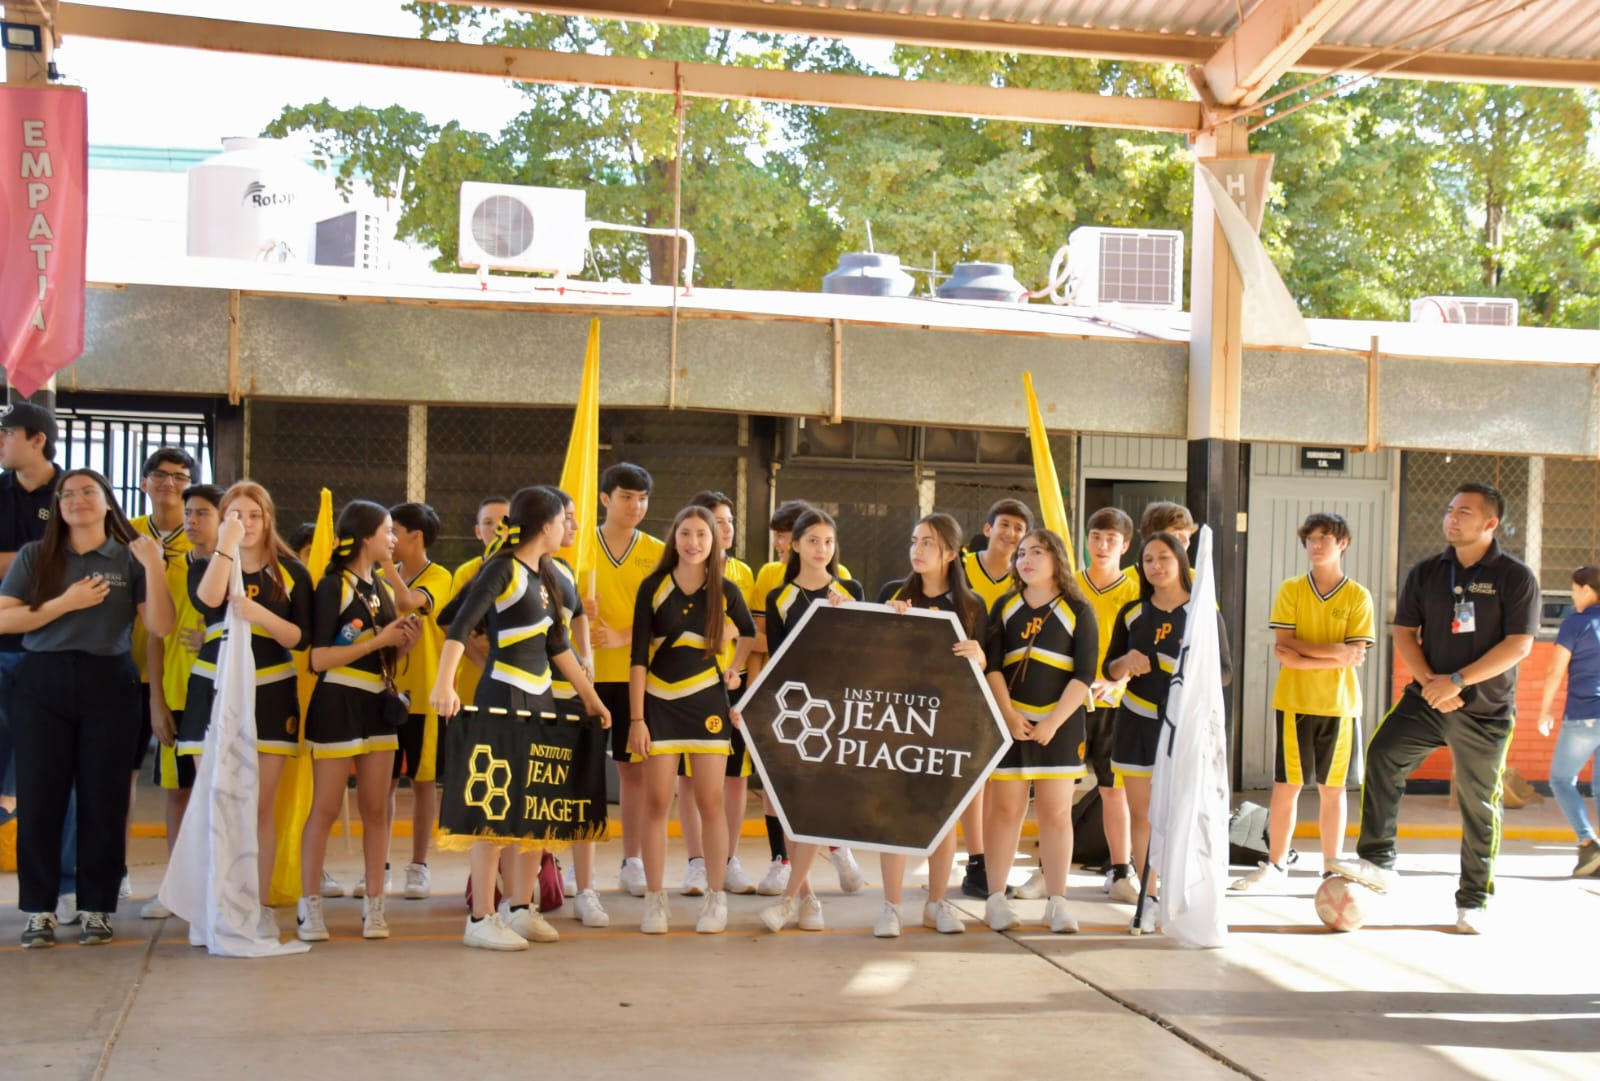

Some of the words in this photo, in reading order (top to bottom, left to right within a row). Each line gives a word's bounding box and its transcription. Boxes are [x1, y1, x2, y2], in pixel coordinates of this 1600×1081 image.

[20, 119, 54, 331] EMPATIA
[844, 687, 941, 709] INSTITUTO
[837, 699, 939, 738] JEAN
[525, 759, 570, 788] JEAN
[834, 737, 972, 778] PIAGET
[524, 794, 592, 823] PIAGET
